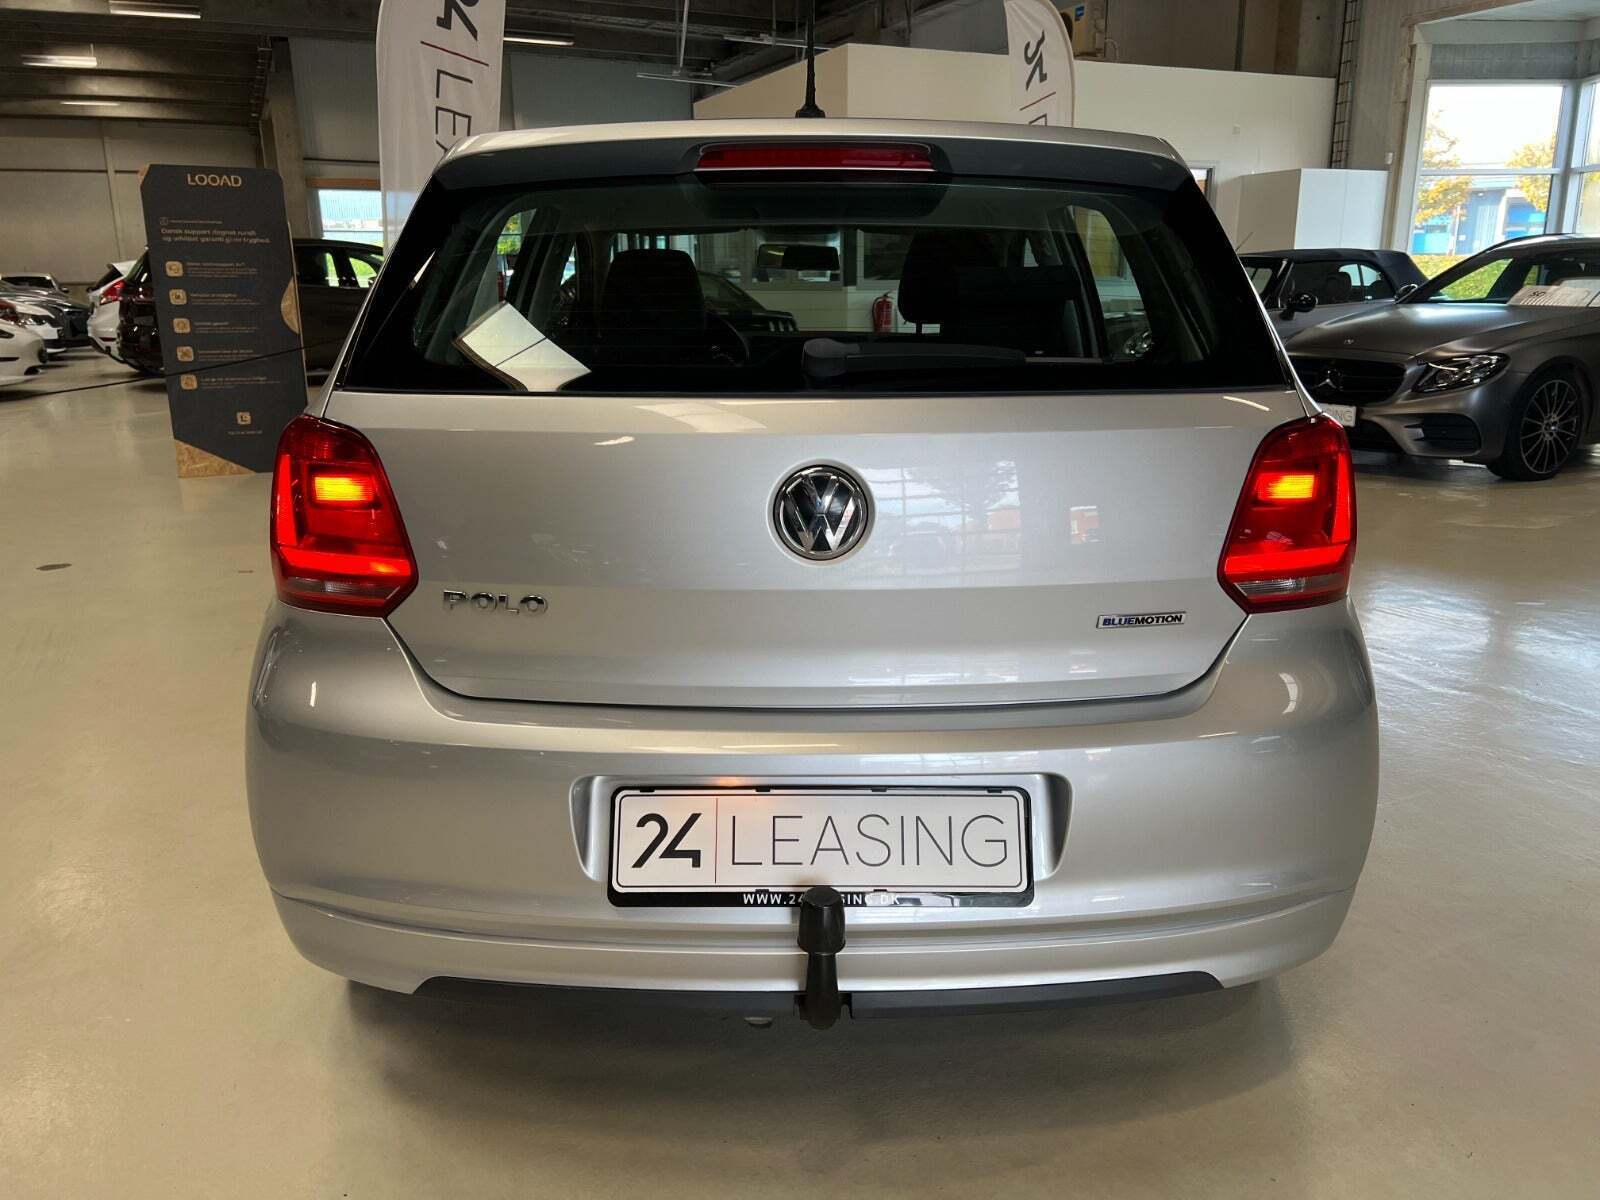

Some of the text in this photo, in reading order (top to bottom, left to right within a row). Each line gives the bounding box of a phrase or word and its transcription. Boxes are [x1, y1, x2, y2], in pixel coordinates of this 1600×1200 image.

[187, 173, 242, 187] LOOAD
[443, 589, 548, 614] POLO
[1102, 614, 1183, 626] BLUEMOTION
[631, 813, 1008, 868] 24 LEASING
